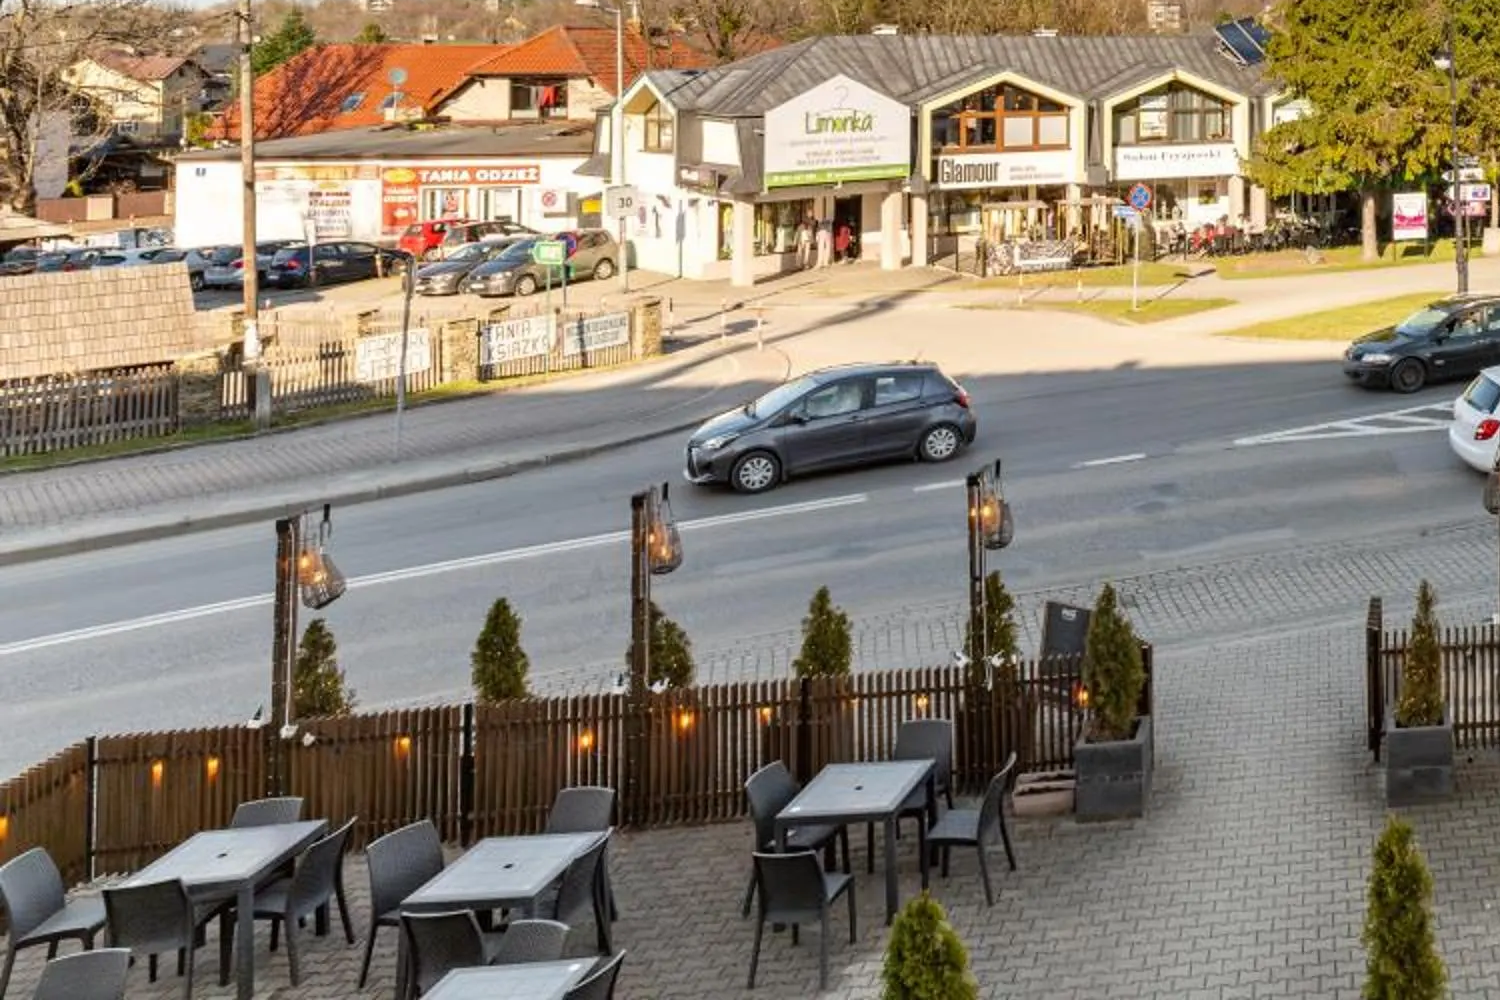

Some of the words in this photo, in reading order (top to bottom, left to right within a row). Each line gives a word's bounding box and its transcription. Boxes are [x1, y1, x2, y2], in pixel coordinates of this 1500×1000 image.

[805, 109, 873, 135] Limonka
[420, 168, 470, 183] TANIA
[941, 158, 1000, 184] Glamour
